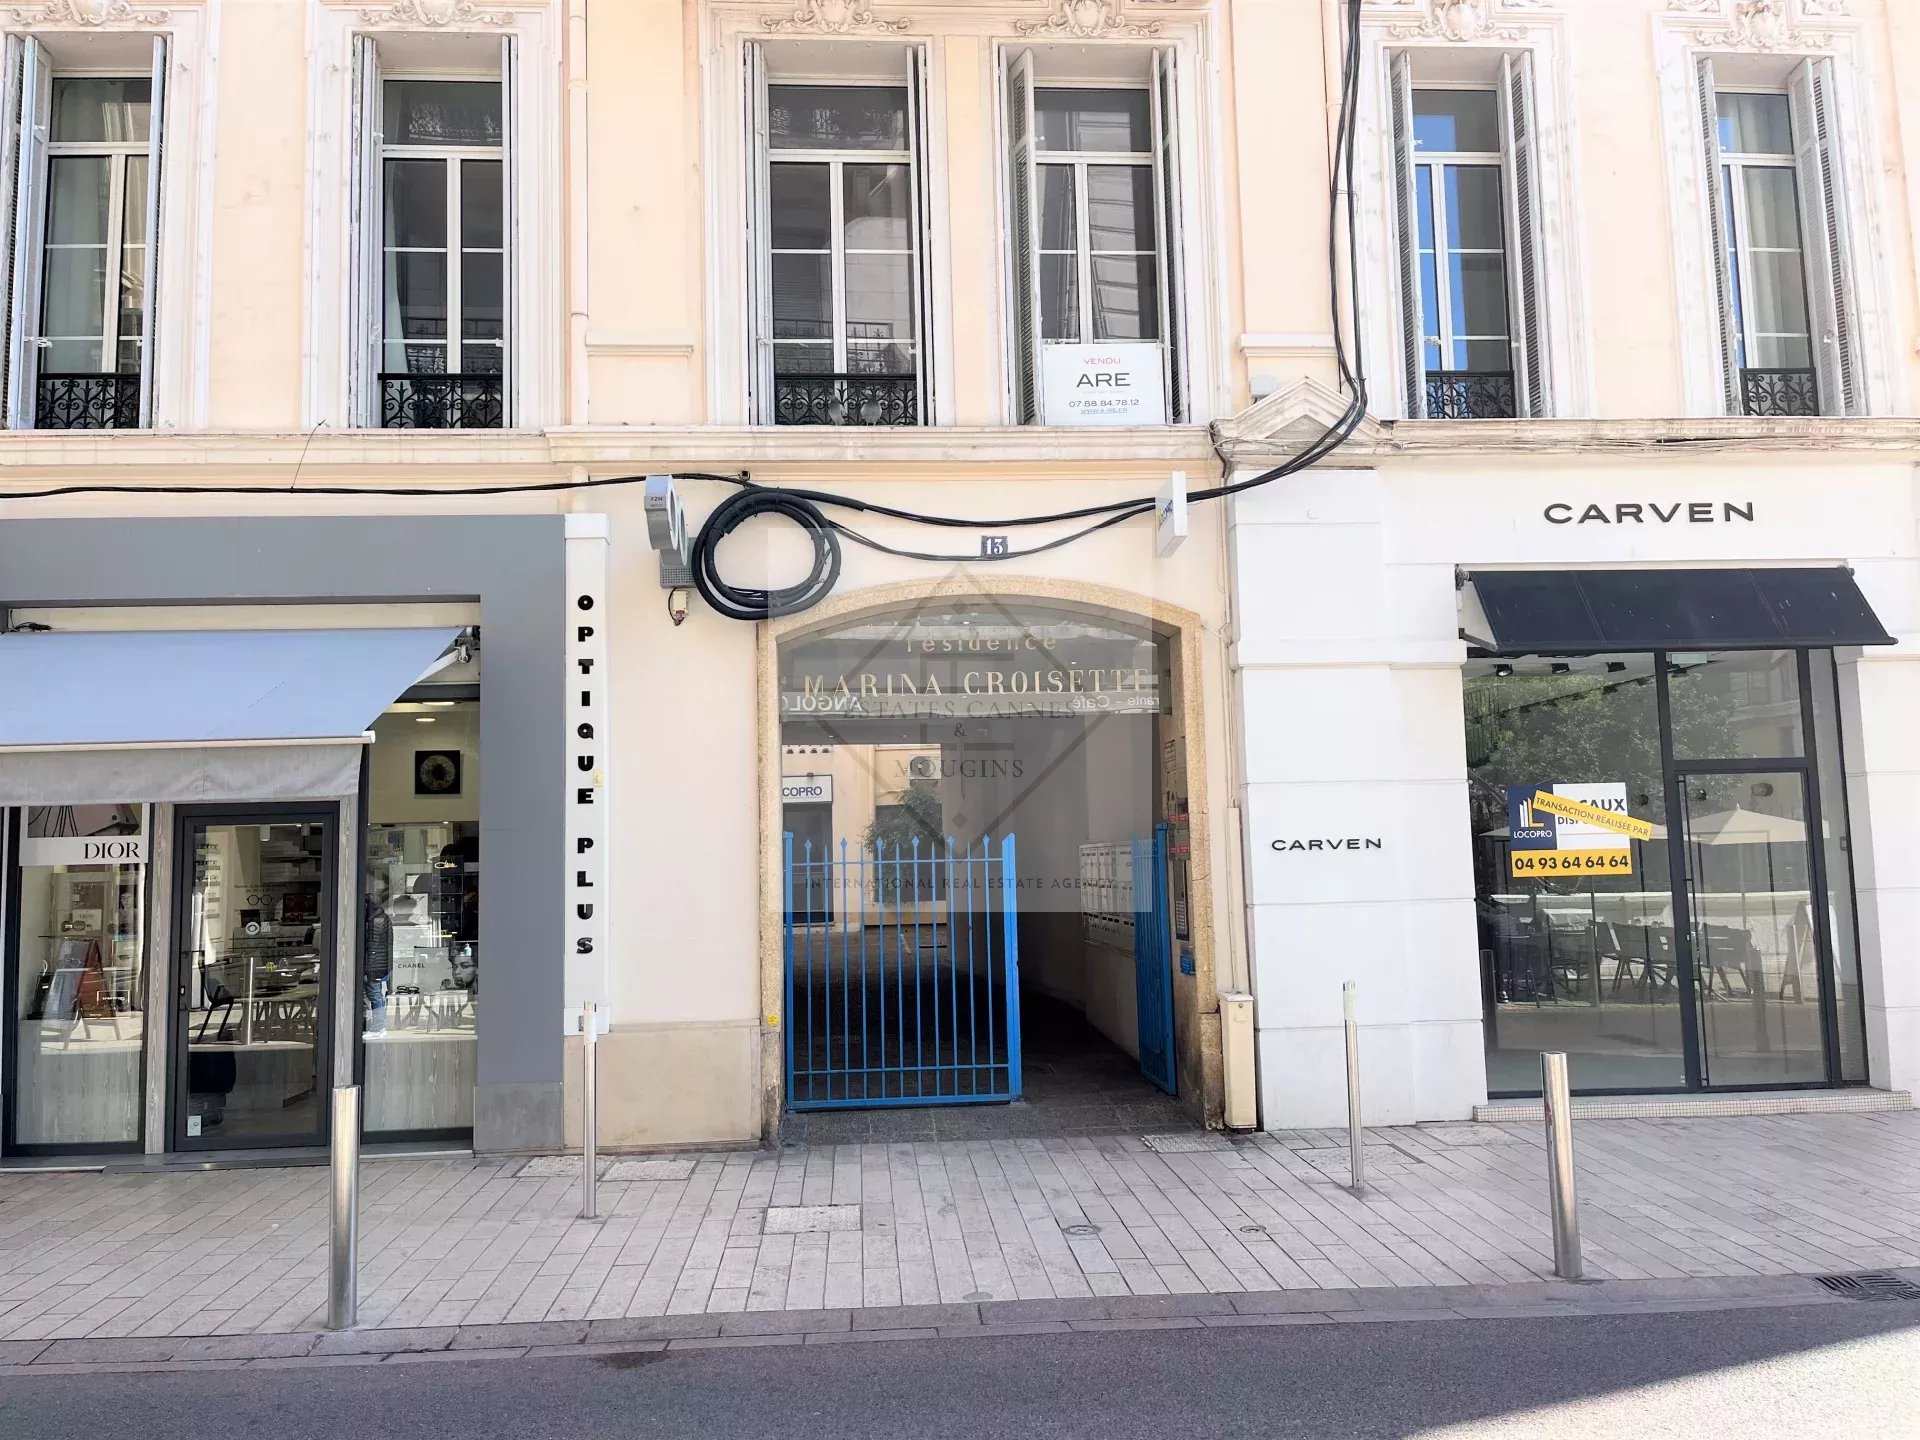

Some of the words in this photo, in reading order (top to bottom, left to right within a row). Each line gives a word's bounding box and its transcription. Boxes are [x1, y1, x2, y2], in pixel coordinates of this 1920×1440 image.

[1083, 357, 1121, 365] VENDU
[1076, 372, 1131, 388] ARE
[1068, 398, 1140, 408] 07.88.84.78.12
[1543, 501, 1755, 525] CARVEN
[986, 538, 1004, 555] 13
[804, 672, 942, 699] MARINA
[963, 667, 1150, 696] CROISETTE
[577, 594, 595, 805] OPTIQUE
[1536, 797, 1594, 820] TRANSACTION
[1595, 814, 1634, 831] RÉALISÉE
[1632, 825, 1650, 836] PAR
[1513, 829, 1553, 839] LOCOPRO
[83, 842, 140, 859] DIOR
[1271, 838, 1382, 851] CARVEN
[1514, 857, 1535, 870] 04
[1538, 856, 1558, 870] 93
[1561, 856, 1582, 869] 64
[1585, 855, 1605, 869] 64
[1609, 855, 1629, 868] 64
[576, 836, 594, 955] PLUS
